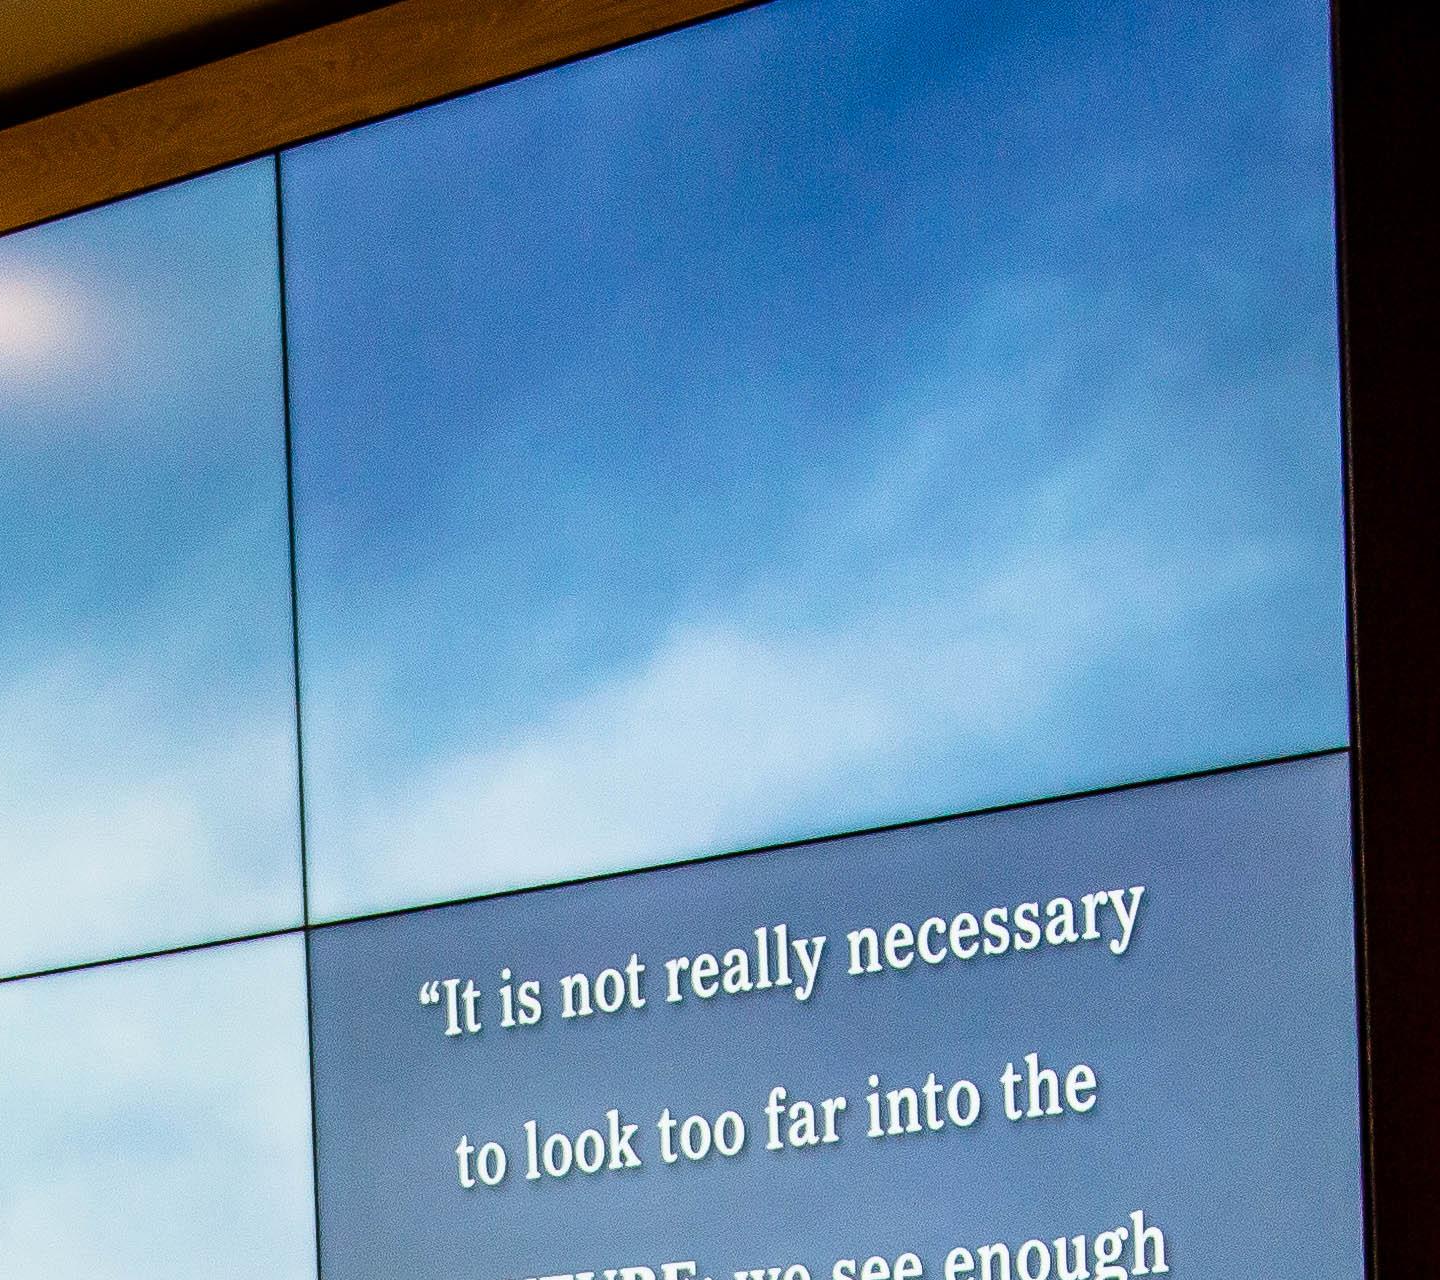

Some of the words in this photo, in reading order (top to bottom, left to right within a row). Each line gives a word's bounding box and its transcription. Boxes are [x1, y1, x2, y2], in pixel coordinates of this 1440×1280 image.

[419, 977, 483, 1037] “It
[498, 966, 543, 1028] is
[558, 952, 647, 1019] not
[664, 922, 828, 1003] really
[845, 885, 1146, 976] necessary
[454, 1133, 508, 1189] to
[522, 1107, 643, 1181] look
[656, 1107, 746, 1164] too
[763, 1085, 848, 1151] far
[865, 1071, 982, 1138] into
[998, 1051, 1098, 1121] the
